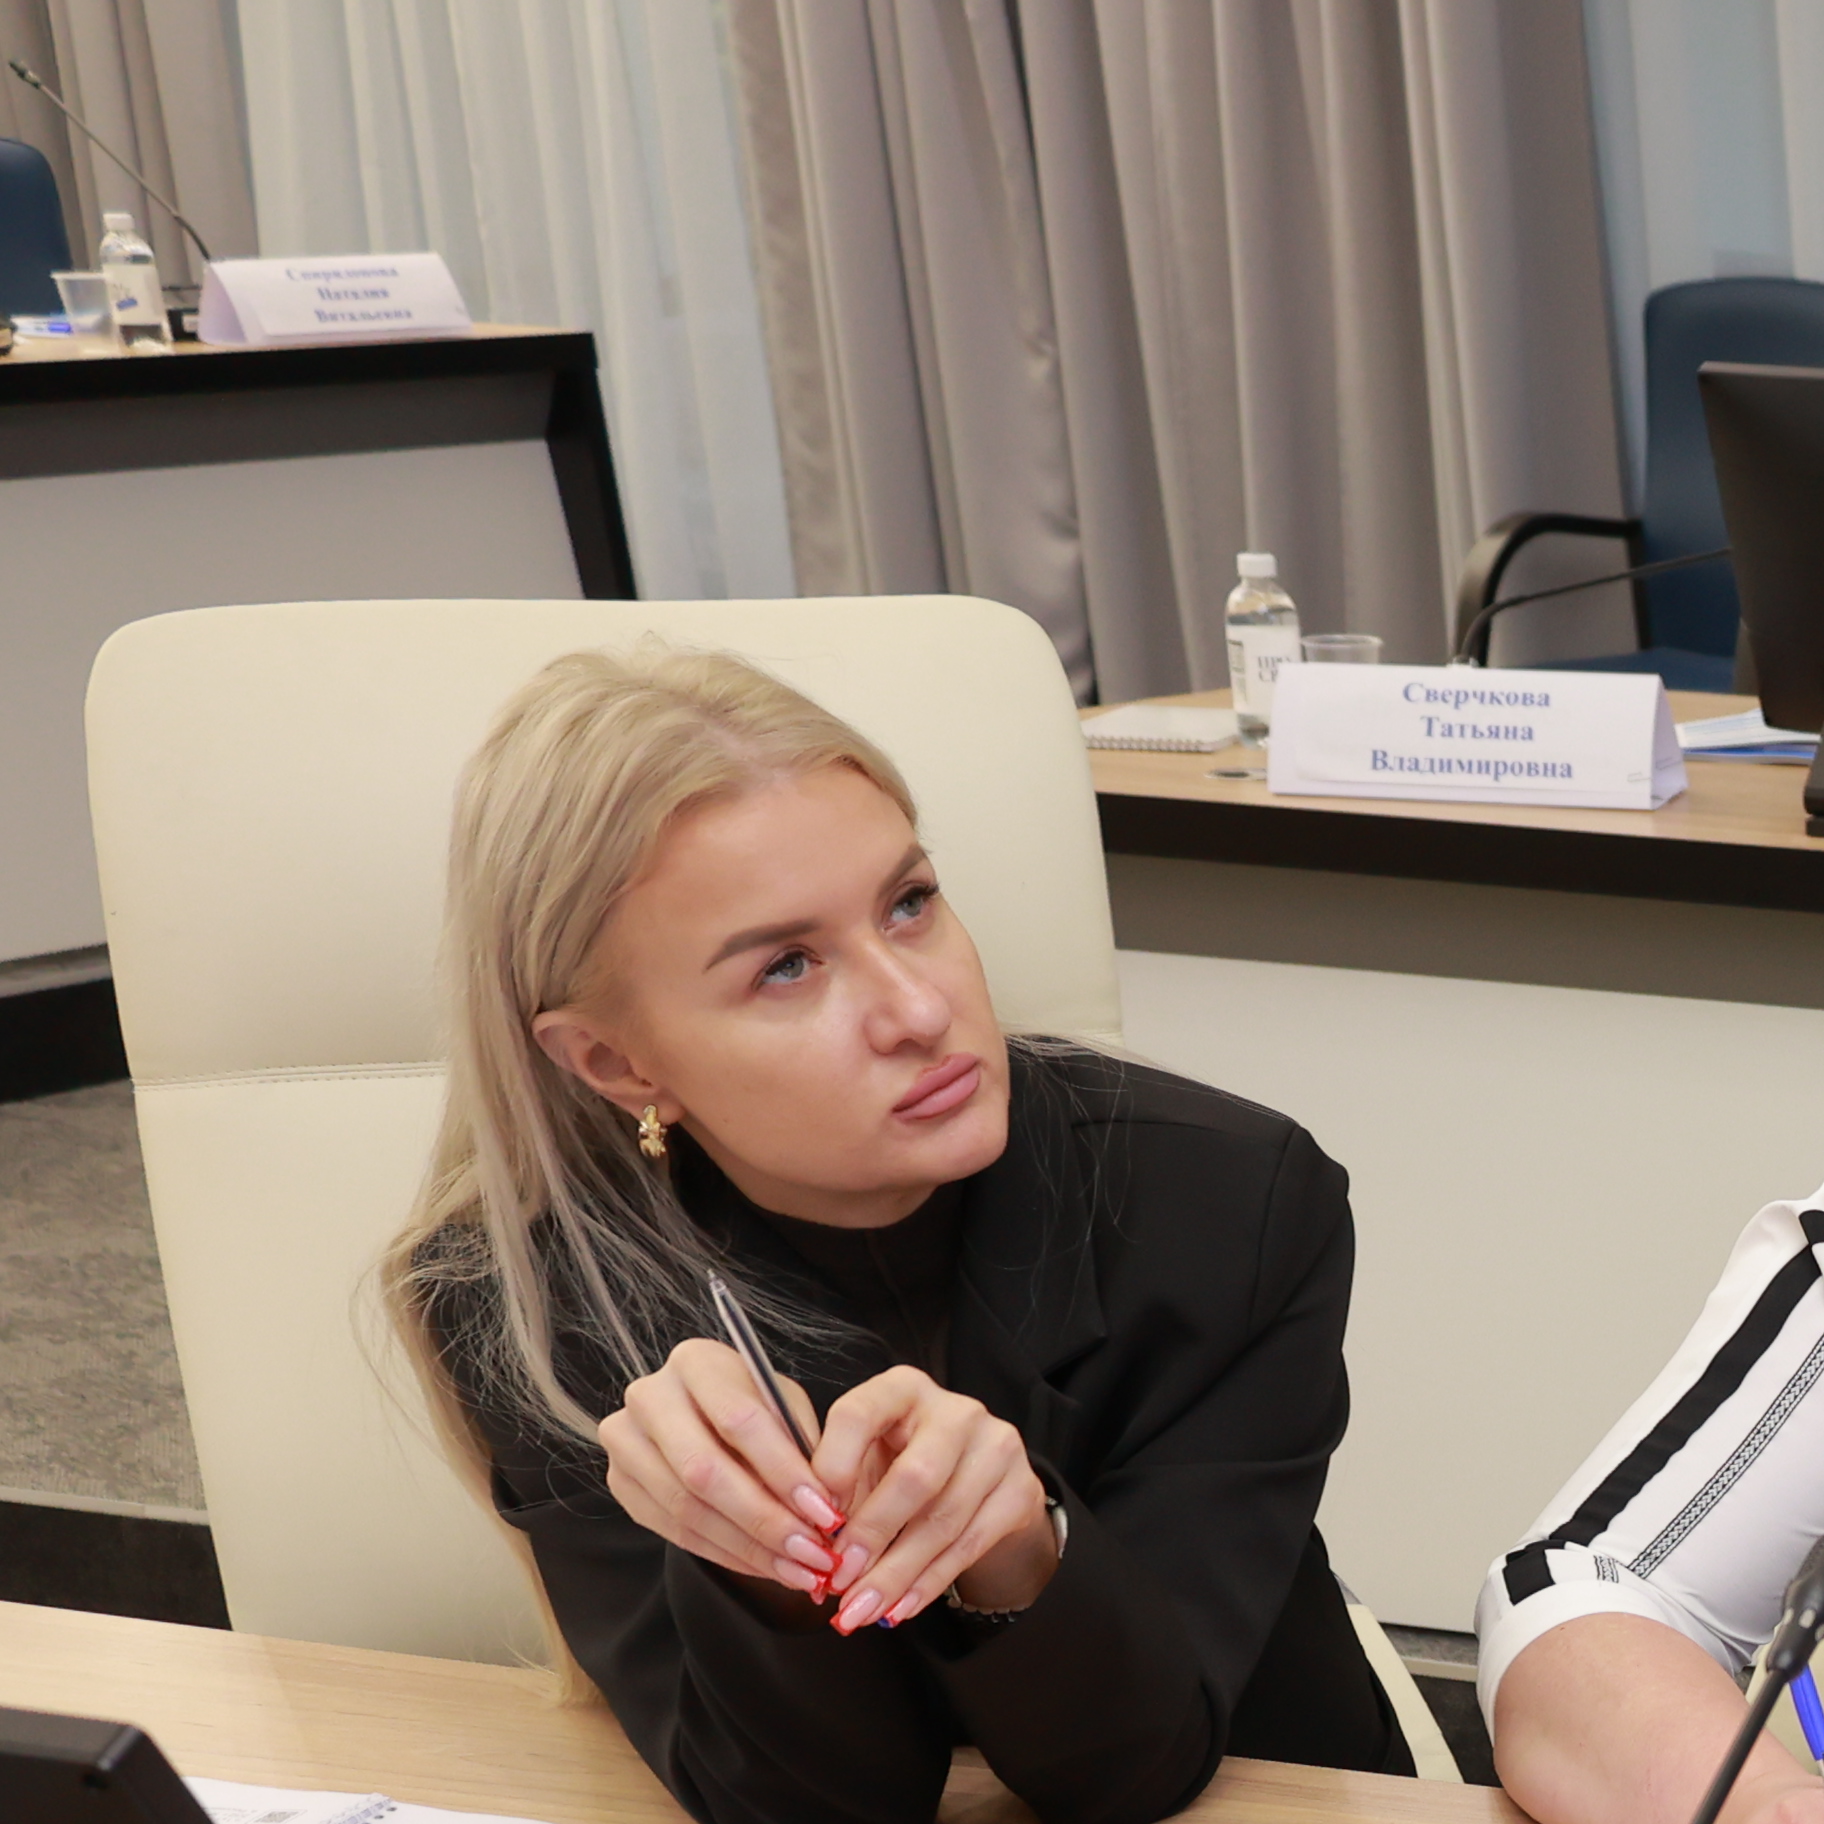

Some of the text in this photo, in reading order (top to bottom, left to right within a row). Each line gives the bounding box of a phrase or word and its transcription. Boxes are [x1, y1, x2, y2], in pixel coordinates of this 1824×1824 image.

[1402, 681, 1552, 709] Сверчкова
[1421, 715, 1535, 742] Татьяна
[1370, 749, 1574, 781] Владимировна
